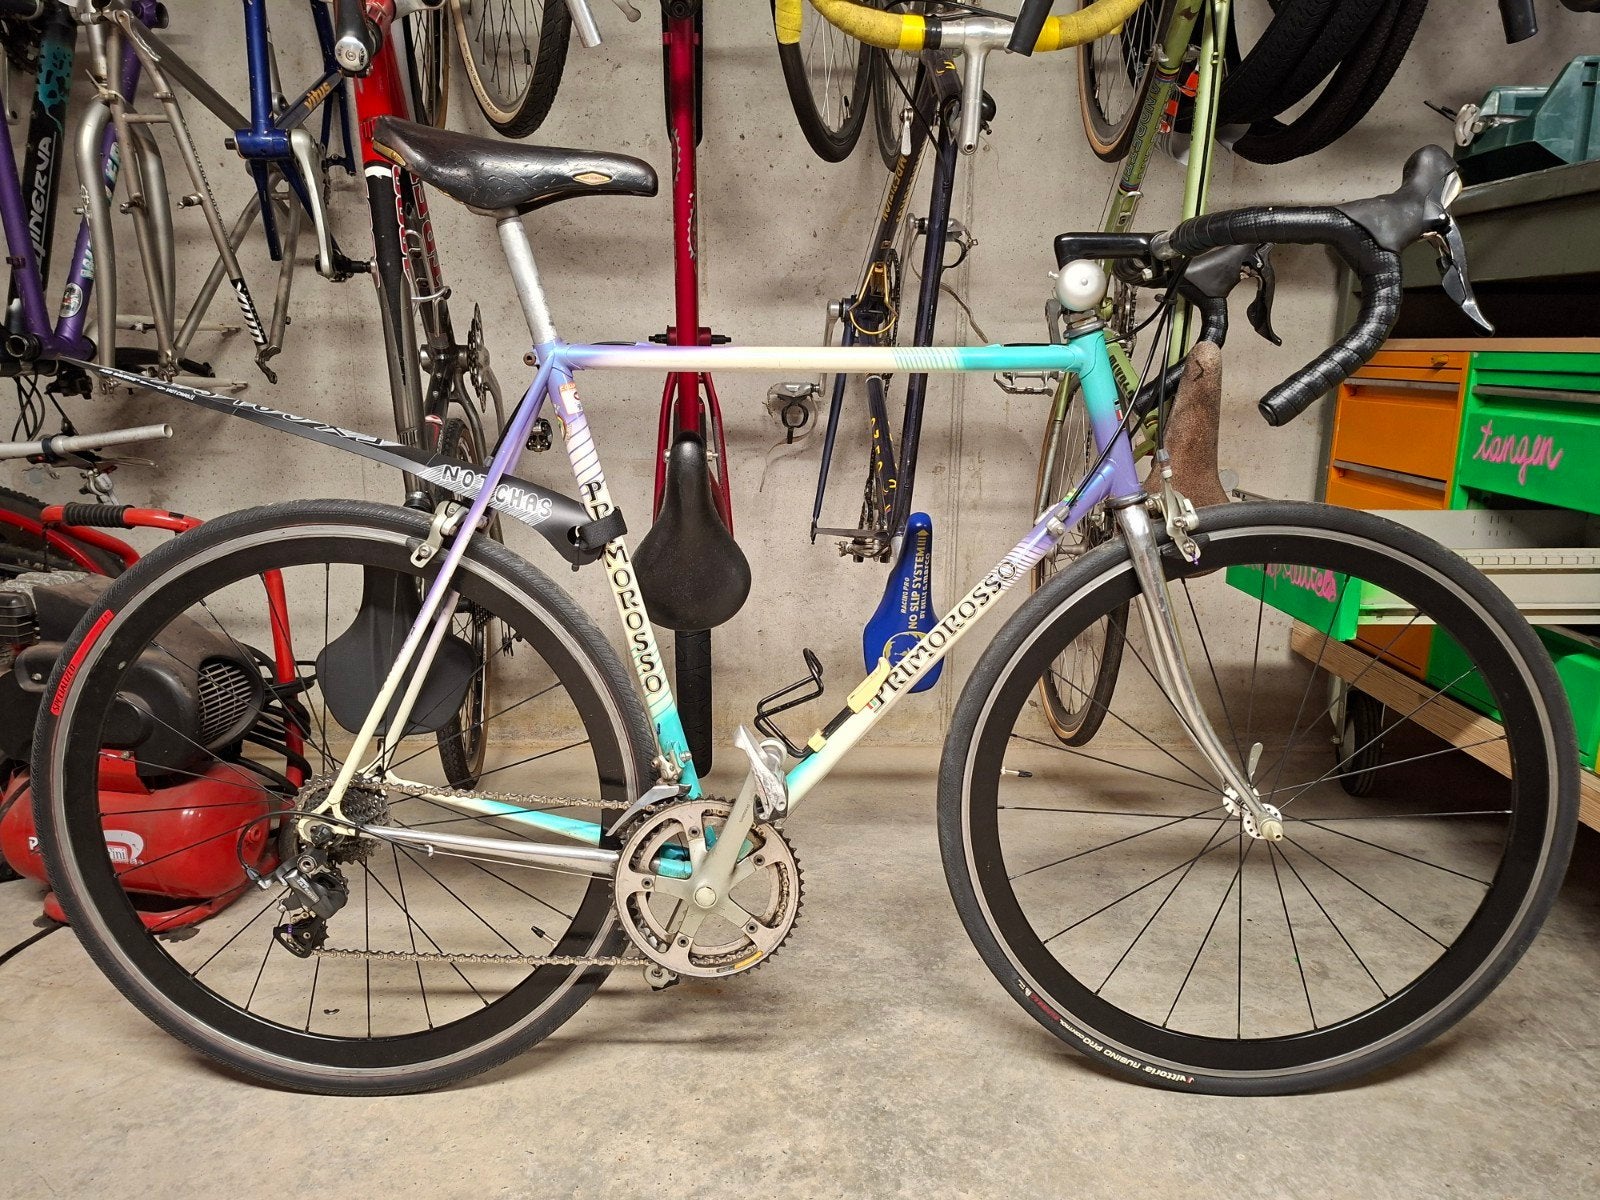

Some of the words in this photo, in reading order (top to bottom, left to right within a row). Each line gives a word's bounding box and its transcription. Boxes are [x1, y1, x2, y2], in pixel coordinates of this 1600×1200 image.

[304, 81, 331, 110] vitus
[1472, 419, 1564, 486] tangen
[912, 548, 926, 589] SYSTEM
[901, 592, 909, 614] RACING
[910, 589, 921, 612] SLIP
[875, 561, 1016, 705] PRIMOROSSO
[908, 614, 918, 630] NO
[52, 663, 76, 711] SPECIALIZED
[1083, 1037, 1104, 1052] PRO
[1103, 1049, 1141, 1069] RUBINO
[1145, 1065, 1187, 1082] vittoria
